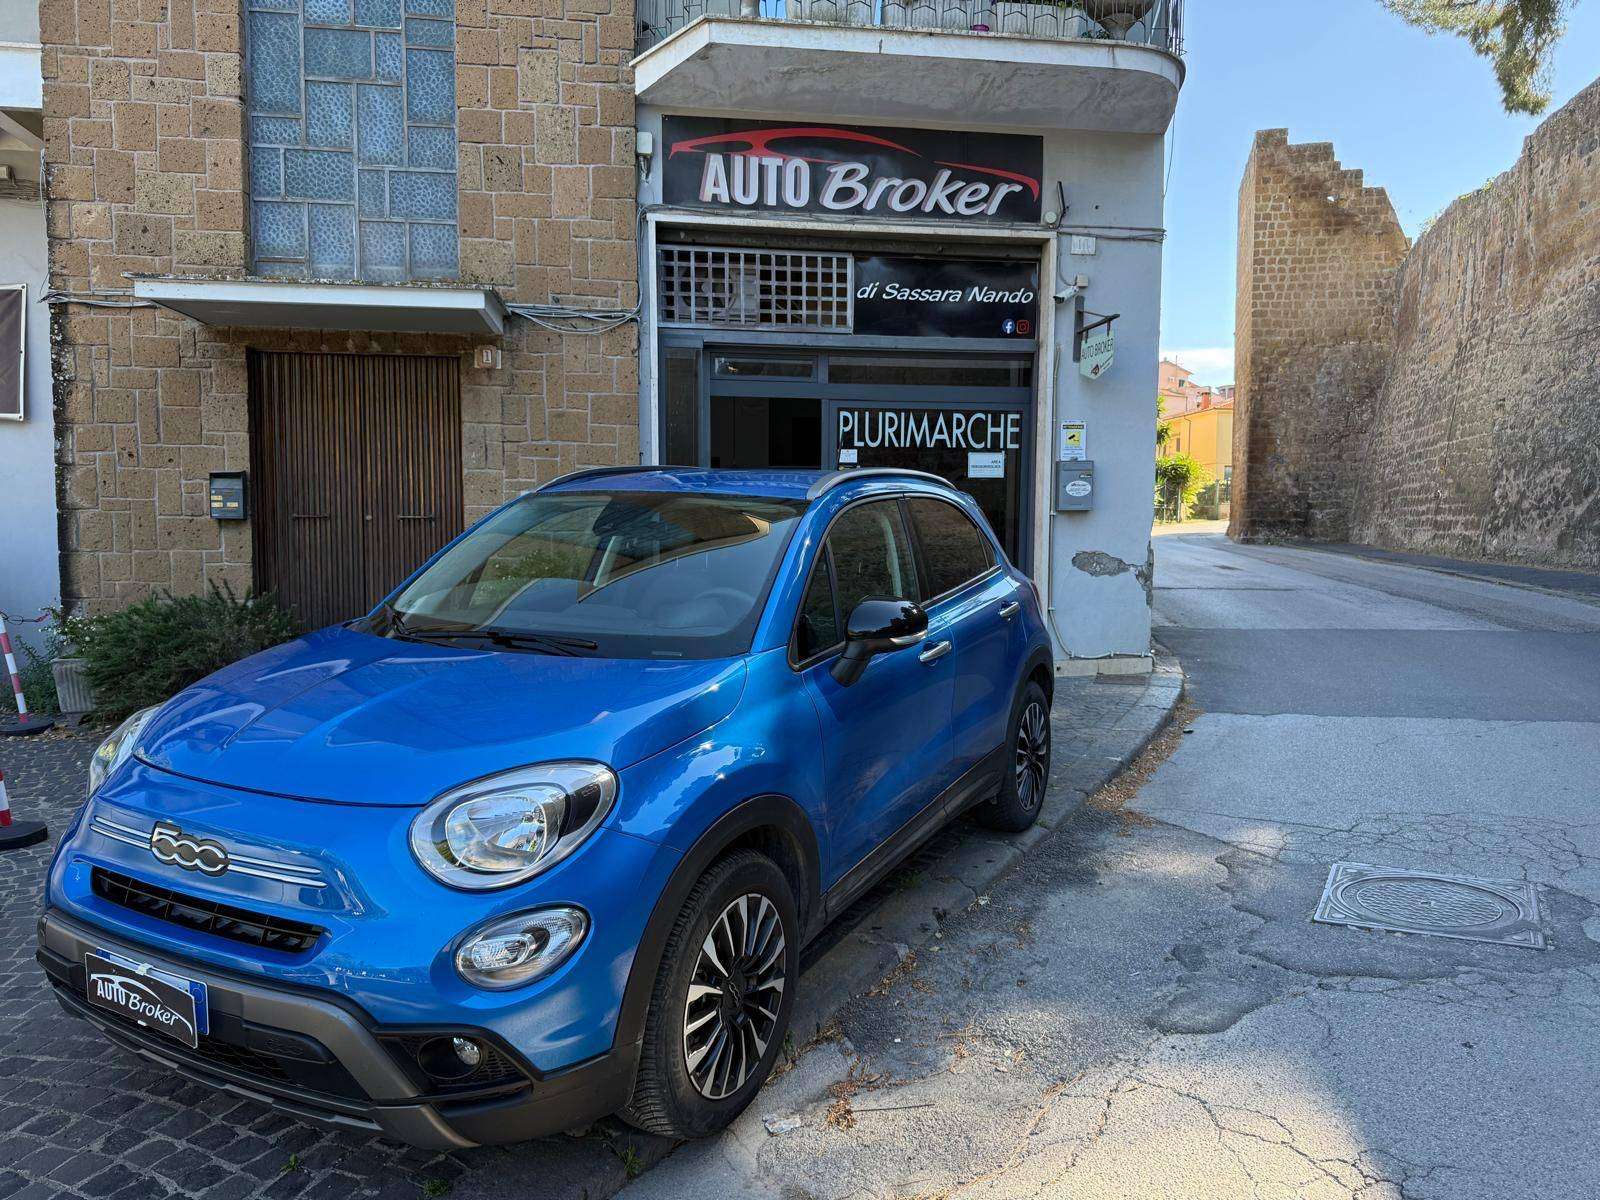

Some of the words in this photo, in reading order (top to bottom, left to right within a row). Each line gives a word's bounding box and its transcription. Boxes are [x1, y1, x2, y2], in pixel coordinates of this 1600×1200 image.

[699, 152, 810, 208] AUTO
[819, 161, 1023, 216] Broker
[856, 282, 876, 300] di
[882, 284, 963, 303] Sassara
[967, 286, 1034, 304] Nando
[1081, 344, 1093, 360] AUTO
[1094, 337, 1114, 357] BROKER
[839, 411, 1020, 449] PLURIMARCHE
[151, 824, 228, 873] 500
[96, 980, 126, 1005] AUTO
[128, 993, 180, 1026] Broker
